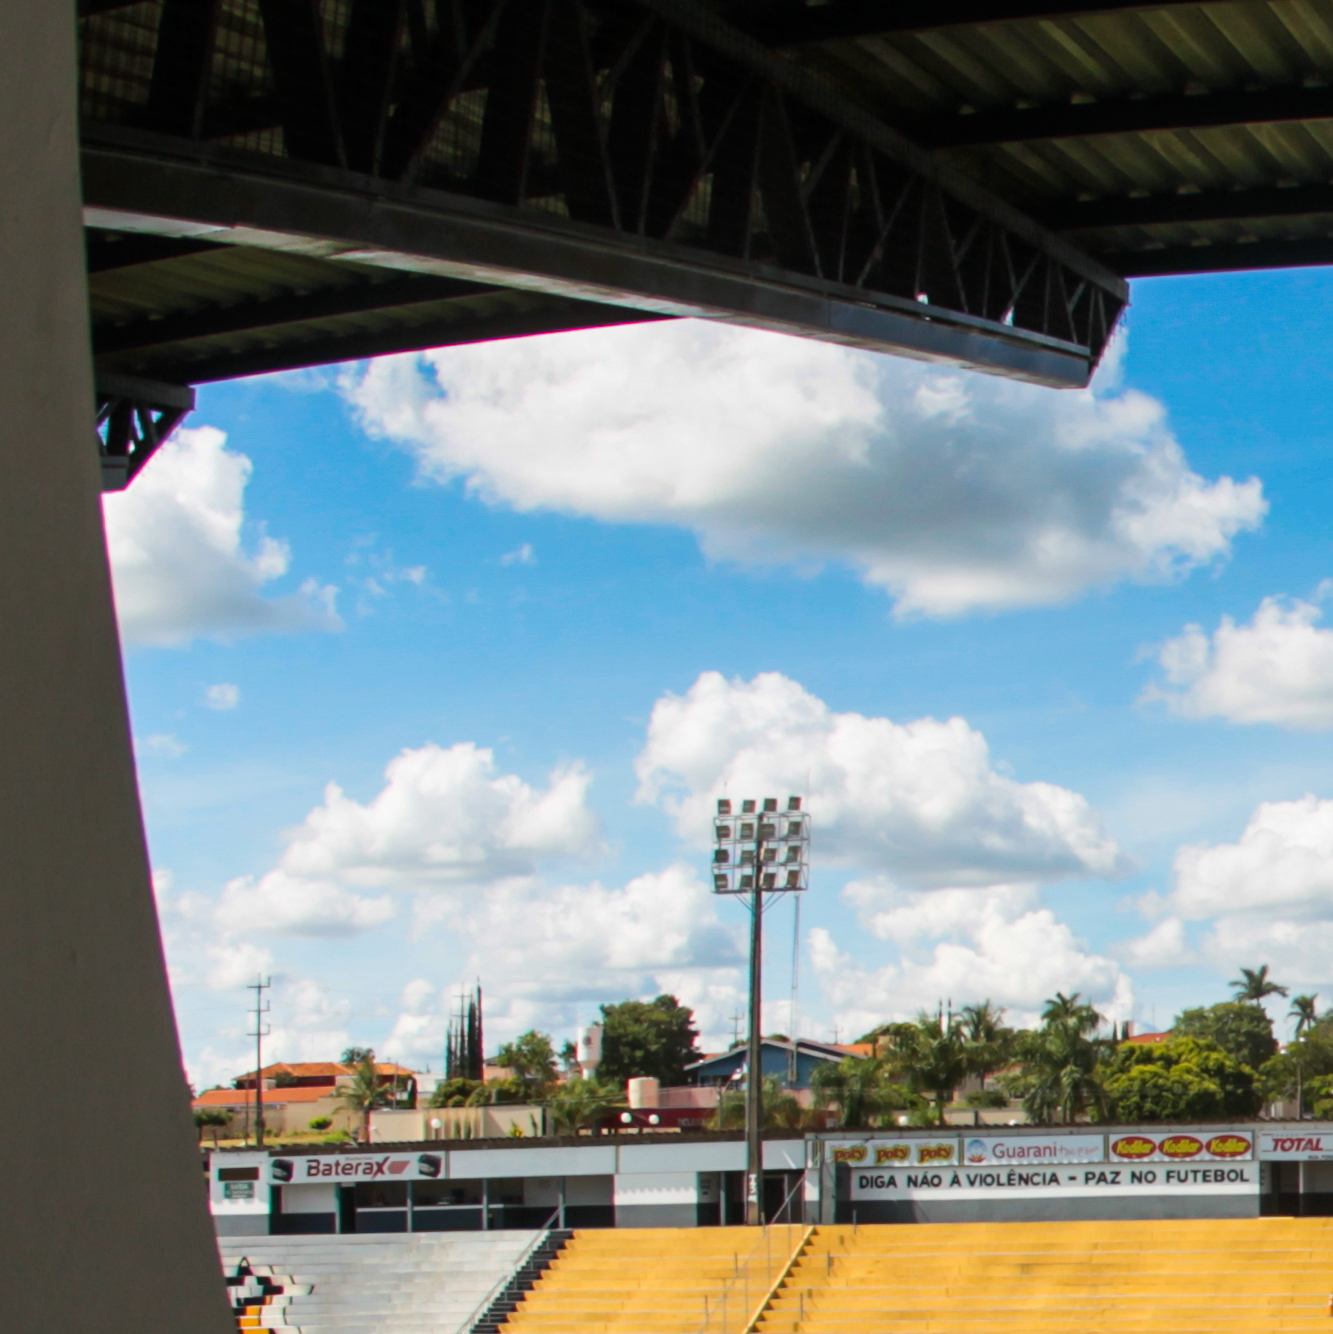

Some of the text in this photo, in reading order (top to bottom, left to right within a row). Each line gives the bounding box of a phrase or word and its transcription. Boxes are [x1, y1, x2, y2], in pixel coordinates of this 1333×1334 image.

[992, 1140, 1057, 1159] Guarani
[1272, 1137, 1324, 1152] TOTAL
[859, 1174, 898, 1189] DIGA
[949, 1170, 962, 1188] À
[966, 1168, 1061, 1187] VIOLÊNCIA
[1084, 1170, 1121, 1185] PAZ
[1130, 1170, 1157, 1185] NO
[1166, 1168, 1250, 1184] FUTEBOL
